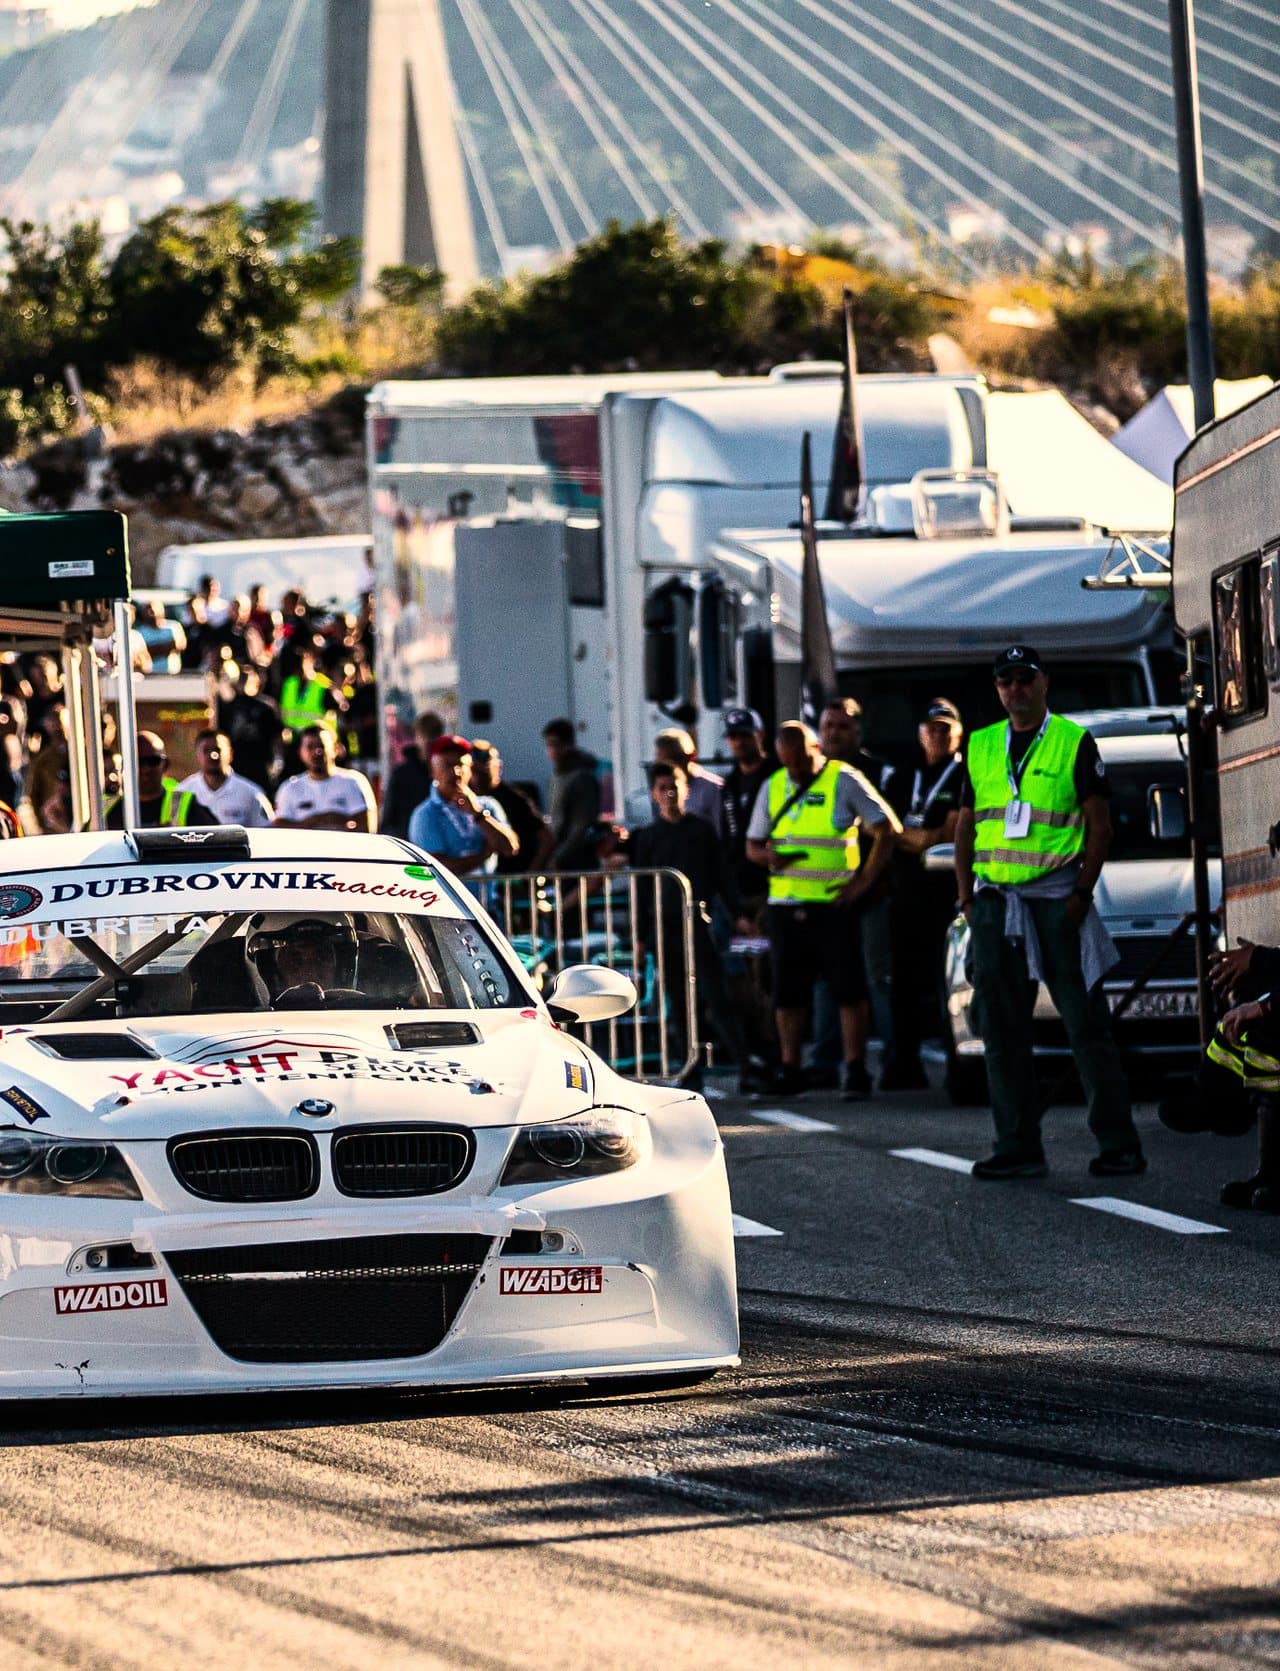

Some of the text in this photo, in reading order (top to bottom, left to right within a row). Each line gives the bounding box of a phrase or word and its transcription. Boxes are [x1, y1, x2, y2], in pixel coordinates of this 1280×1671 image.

[50, 872, 440, 907] DUBROVNIK racing
[0, 915, 213, 946] DUBRETA
[108, 1051, 299, 1090] YACHT
[326, 1063, 471, 1076] SERVICE
[500, 1268, 601, 1293] WLADOIL
[56, 1281, 166, 1312] WLADOIL
